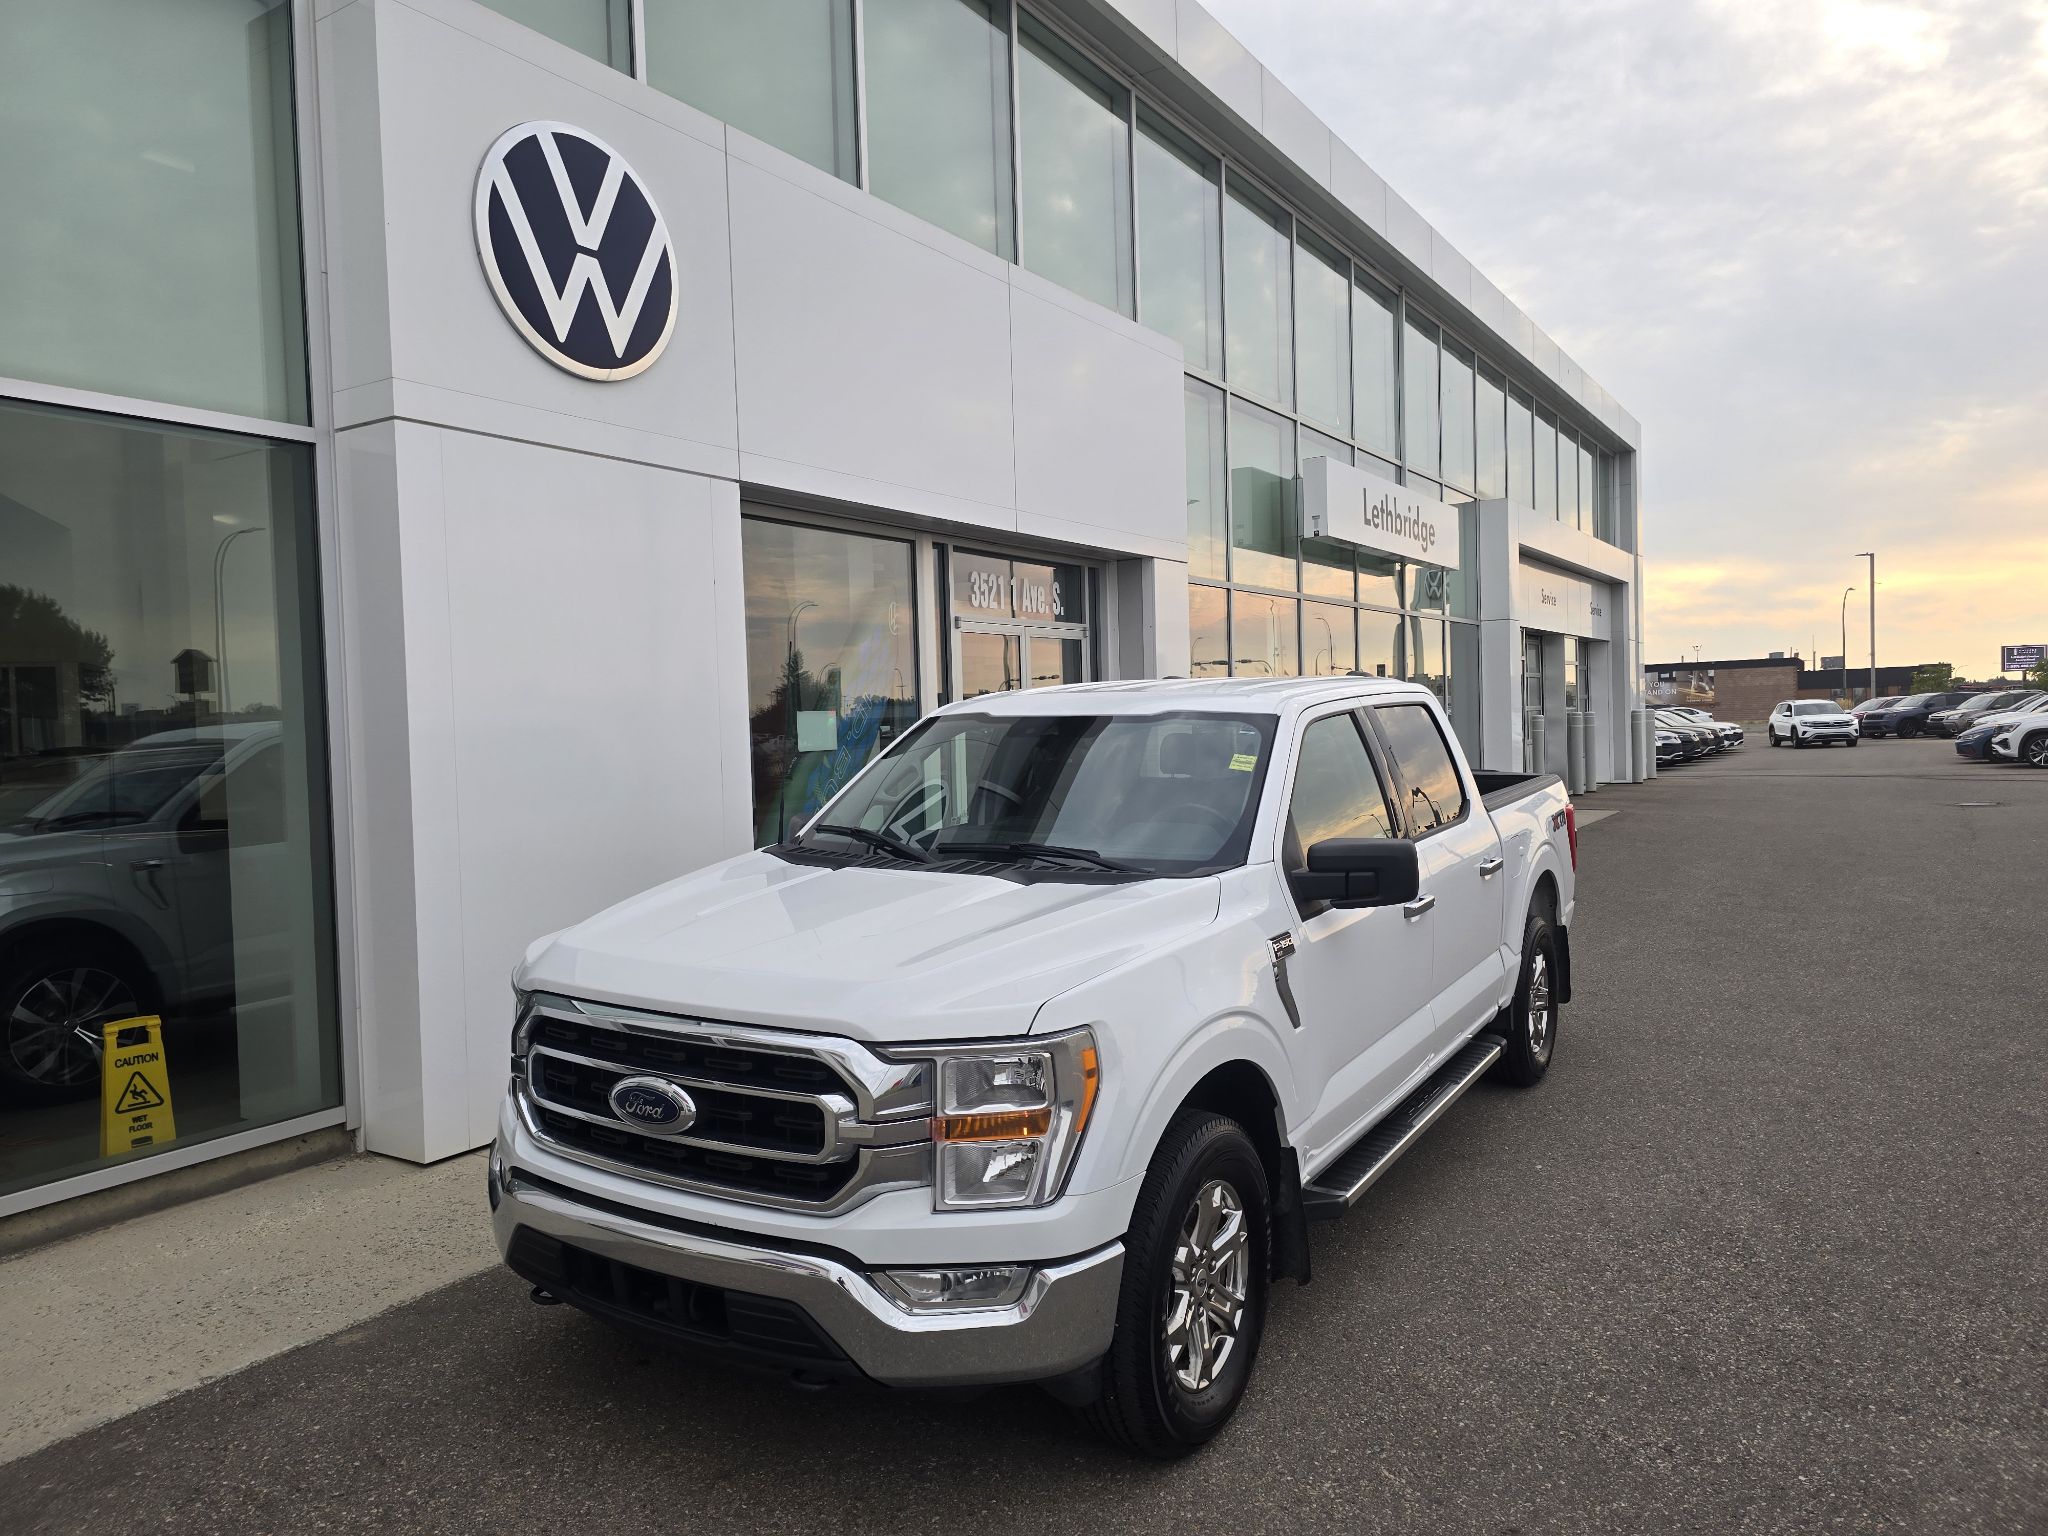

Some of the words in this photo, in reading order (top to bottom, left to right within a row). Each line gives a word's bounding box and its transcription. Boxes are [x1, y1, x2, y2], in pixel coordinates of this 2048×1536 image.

[1363, 487, 1436, 553] Lethbridge
[970, 570, 1005, 610] 3521
[1010, 576, 1017, 611] 1
[1022, 577, 1049, 614] Ave.
[1052, 581, 1065, 616] S.
[115, 1051, 159, 1069] CAUTION
[625, 1091, 666, 1119] Ford
[129, 1122, 153, 1133] FLOOR
[132, 1114, 148, 1123] WET
